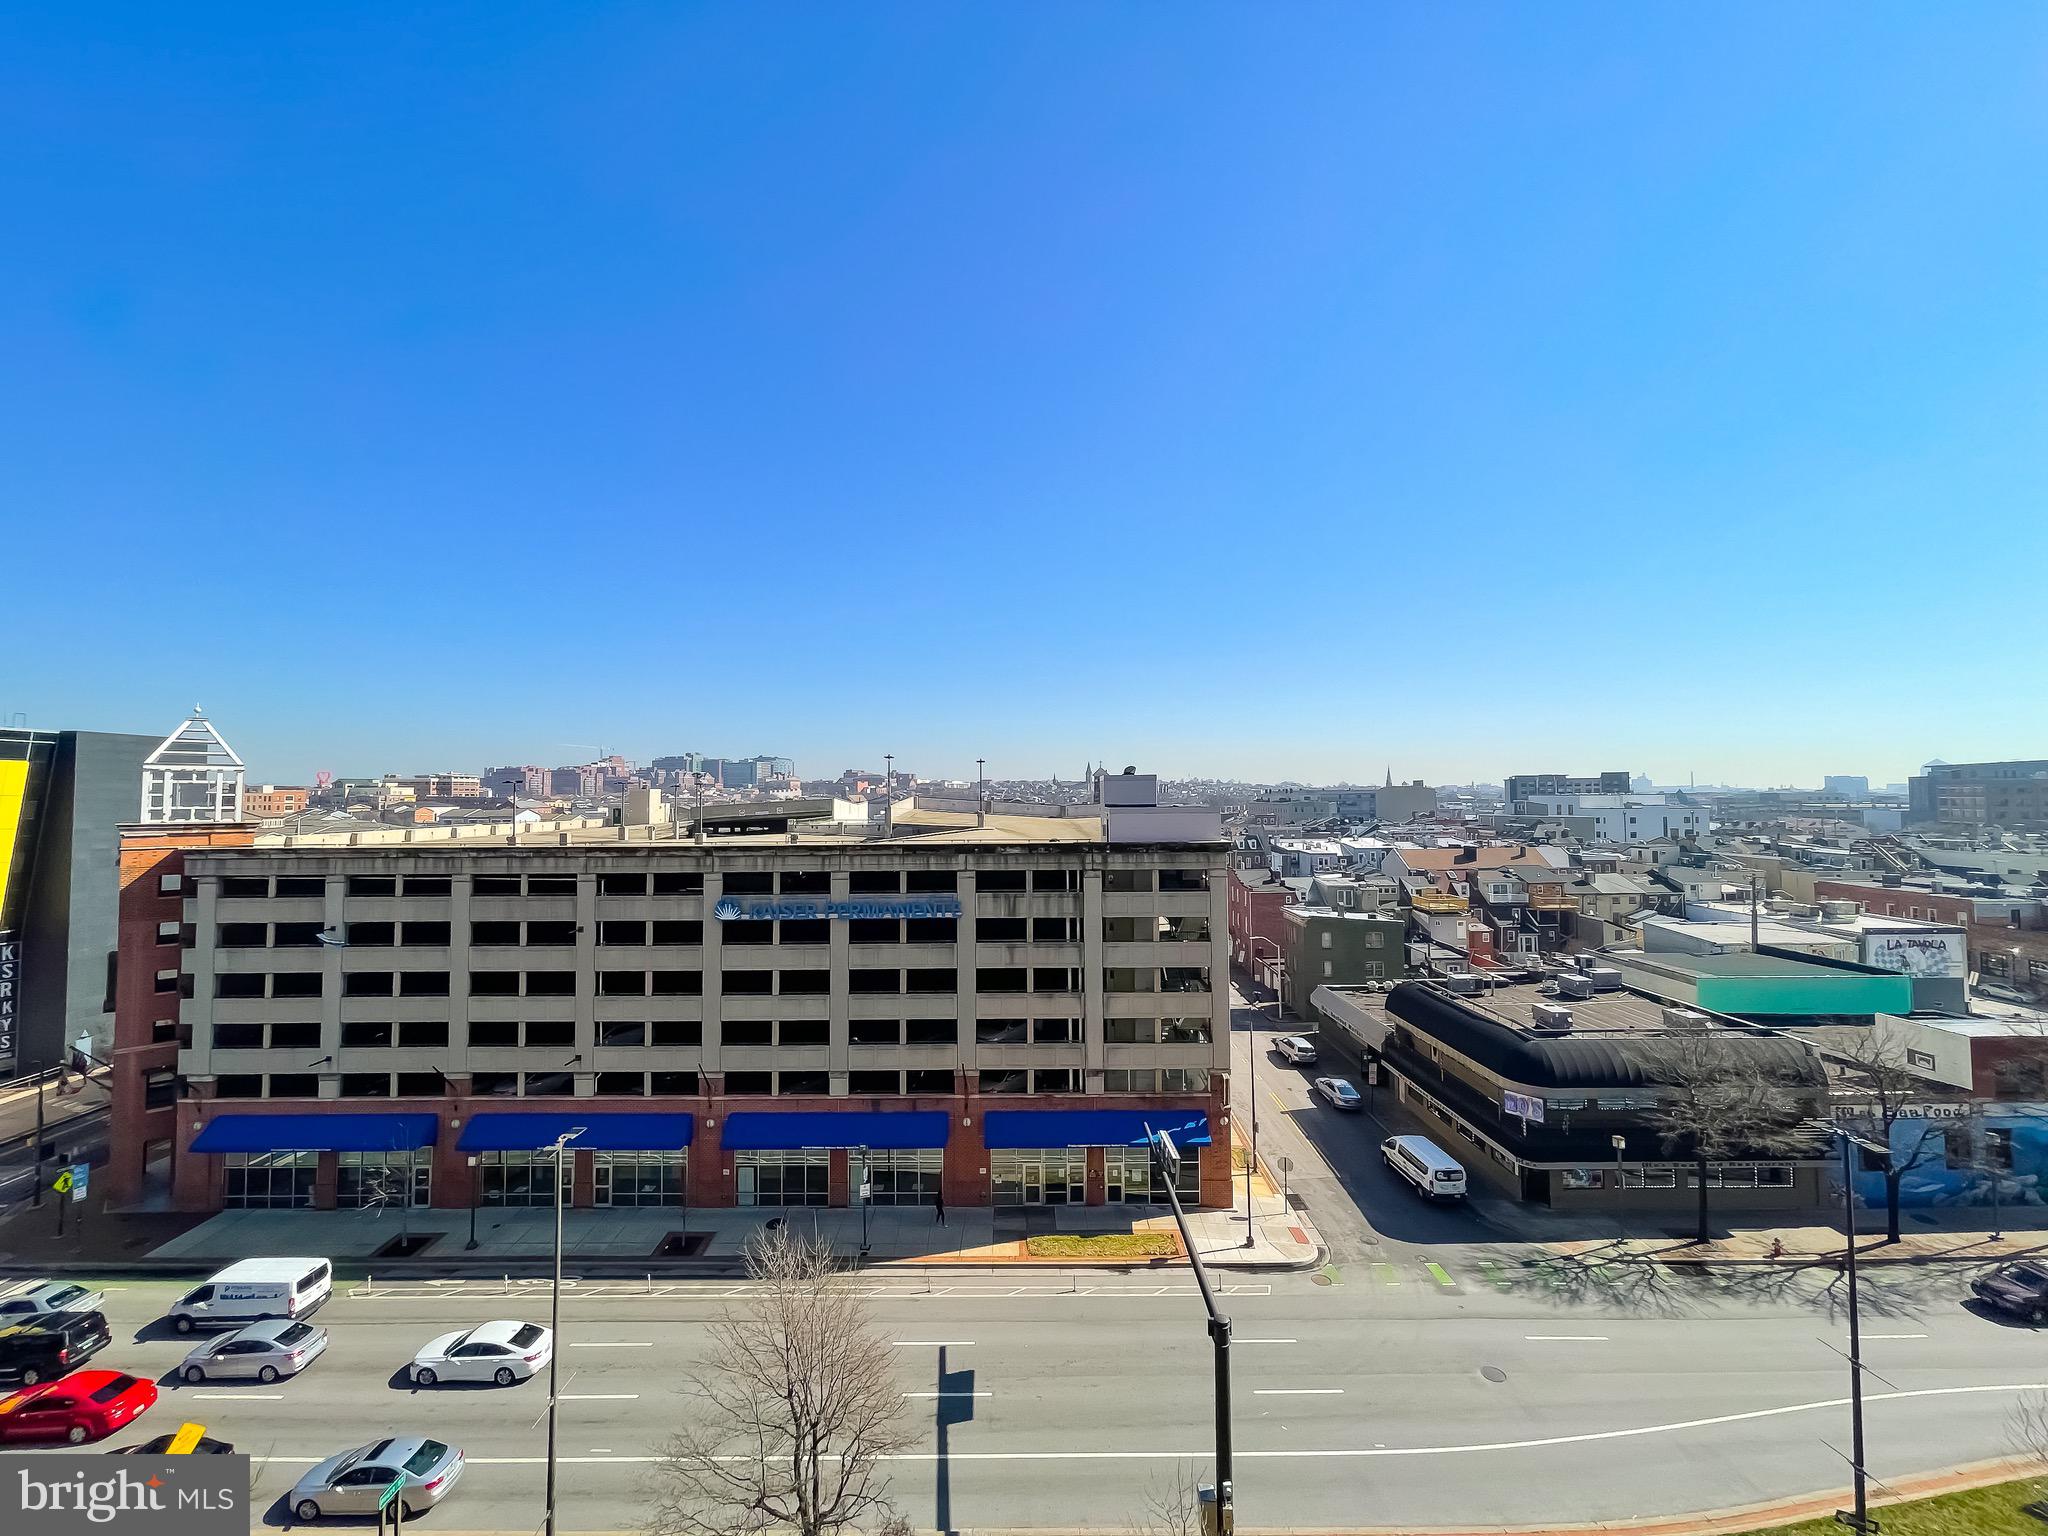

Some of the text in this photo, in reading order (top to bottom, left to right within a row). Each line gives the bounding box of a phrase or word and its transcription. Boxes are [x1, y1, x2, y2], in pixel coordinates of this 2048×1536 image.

[749, 901, 962, 919] KAISER PERMANENTE
[1887, 939, 1947, 954] LA TAVOLA
